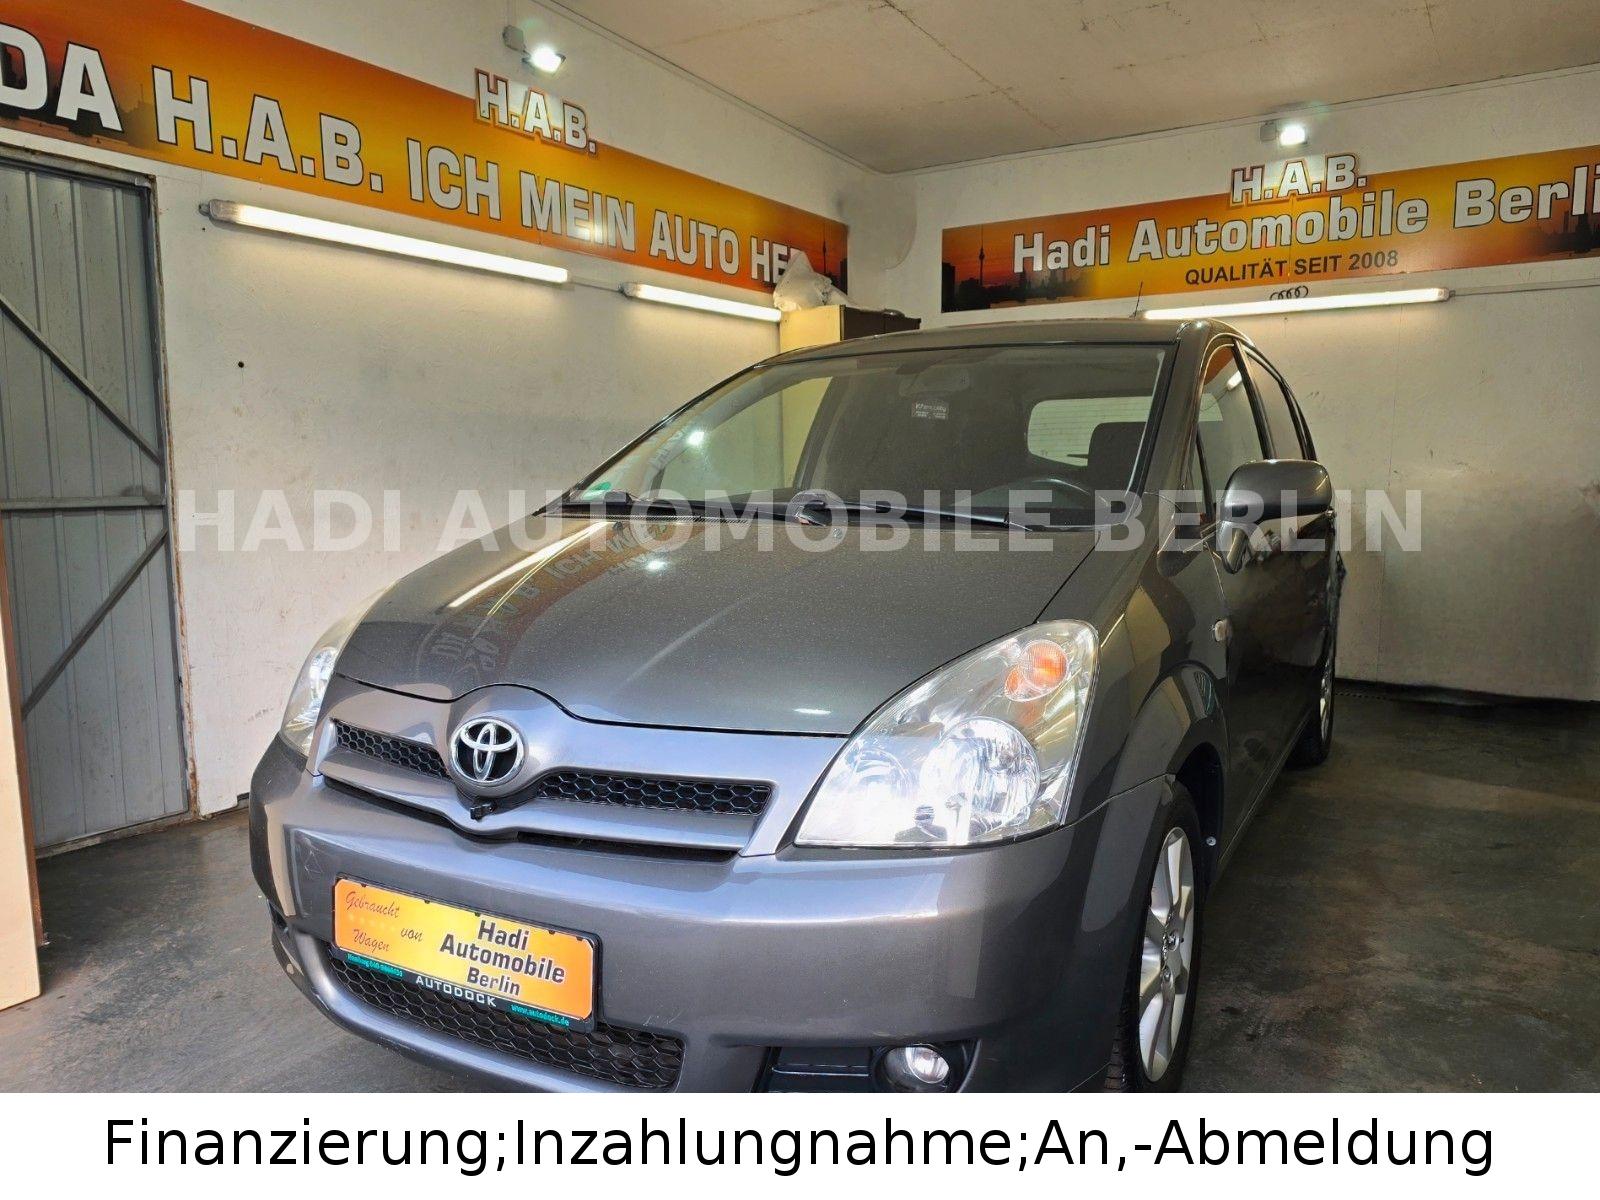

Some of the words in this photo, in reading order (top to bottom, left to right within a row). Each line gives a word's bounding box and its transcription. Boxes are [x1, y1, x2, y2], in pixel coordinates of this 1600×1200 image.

[475, 72, 598, 155] H.A.B.
[0, 22, 124, 133] DA
[151, 65, 384, 193] H.A.B.
[406, 138, 501, 221] ICH
[519, 170, 637, 252] MEIN
[649, 209, 740, 275] AUTO
[750, 236, 805, 285] HE
[1232, 154, 1368, 204] H.A.B.
[1013, 223, 1111, 274] Hadi
[1129, 189, 1429, 262] Automobile
[1185, 258, 1288, 286] QUALITÄT
[1294, 255, 1343, 276] SEIT
[1348, 250, 1399, 271] 2008
[345, 891, 400, 919] Gebraucht
[353, 928, 391, 952] Wagen
[400, 926, 424, 942] von
[477, 919, 530, 951] Hadi
[440, 933, 566, 984] Automobile
[415, 975, 497, 1008] AUTODOCK
[467, 966, 521, 996] Berlin
